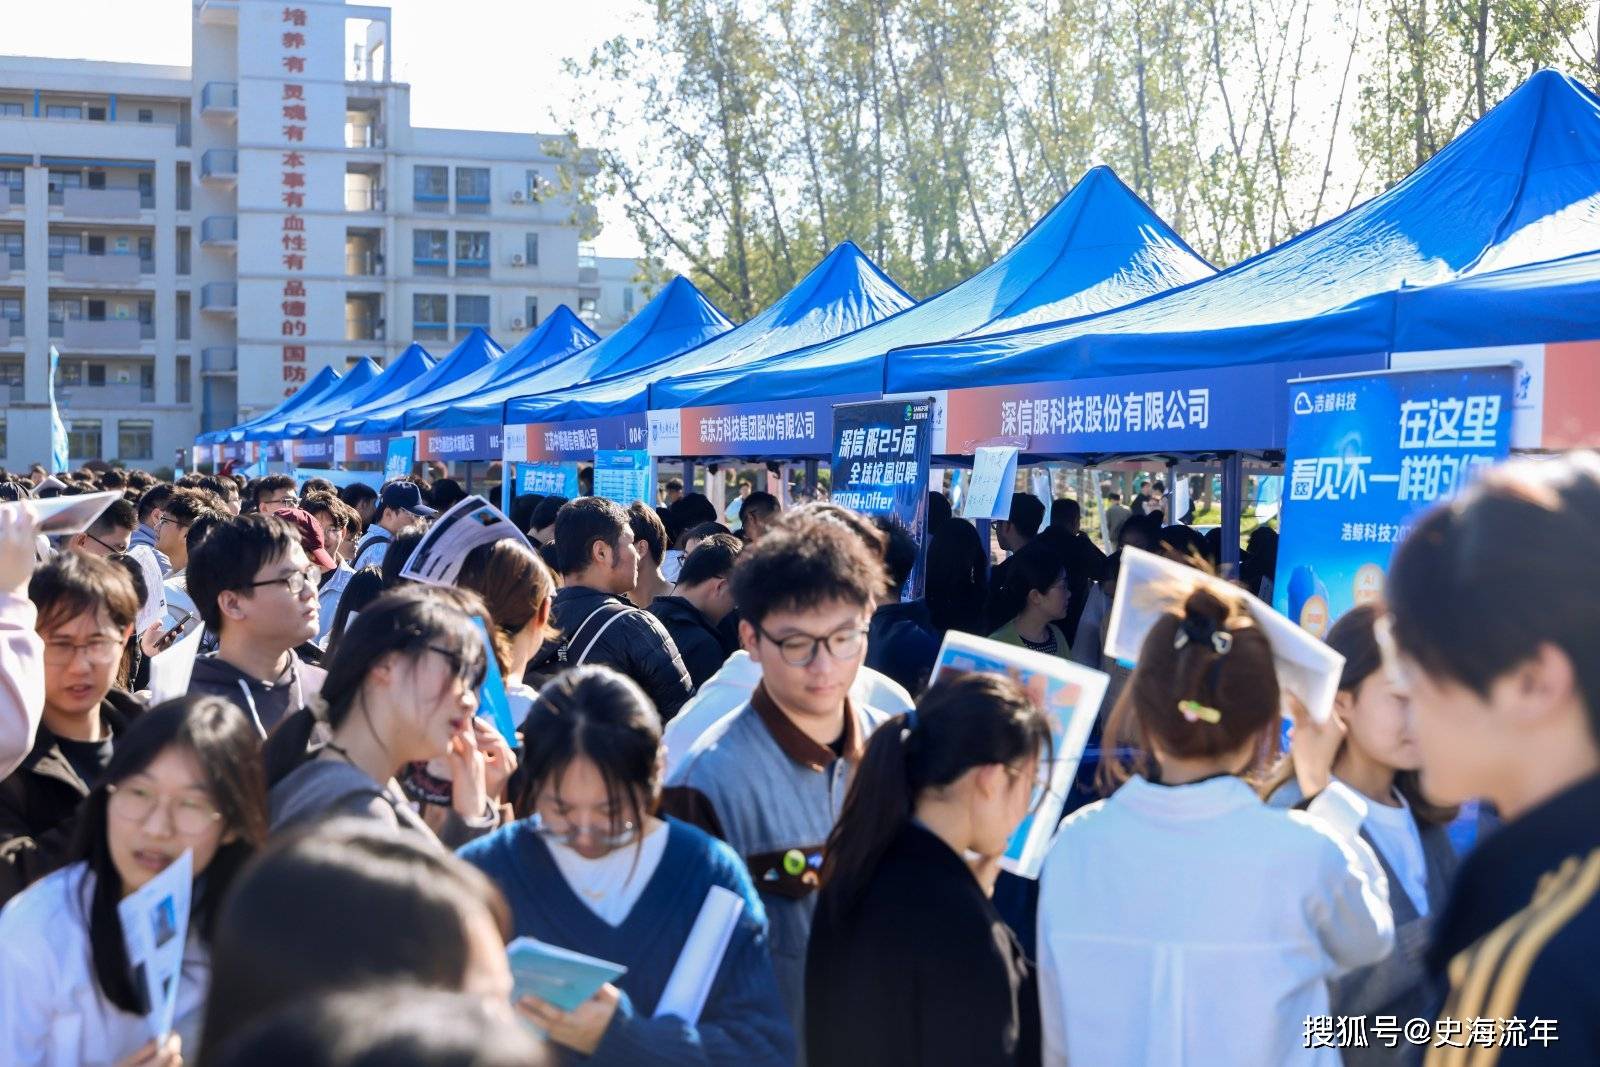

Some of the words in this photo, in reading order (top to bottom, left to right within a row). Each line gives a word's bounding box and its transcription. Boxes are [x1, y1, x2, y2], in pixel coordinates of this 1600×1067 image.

[282, 8, 307, 397] 培养有灵魂有本事有血性有品德的国防
[1001, 388, 1209, 436] 深信服科技股份有限公司
[1314, 392, 1357, 413] 浩鲸科技
[700, 411, 815, 443] 京东方科技集团股份有限公司
[1399, 395, 1501, 449] 在这里
[839, 425, 918, 460] 深信服25届
[848, 462, 918, 485] 全球校园招聘
